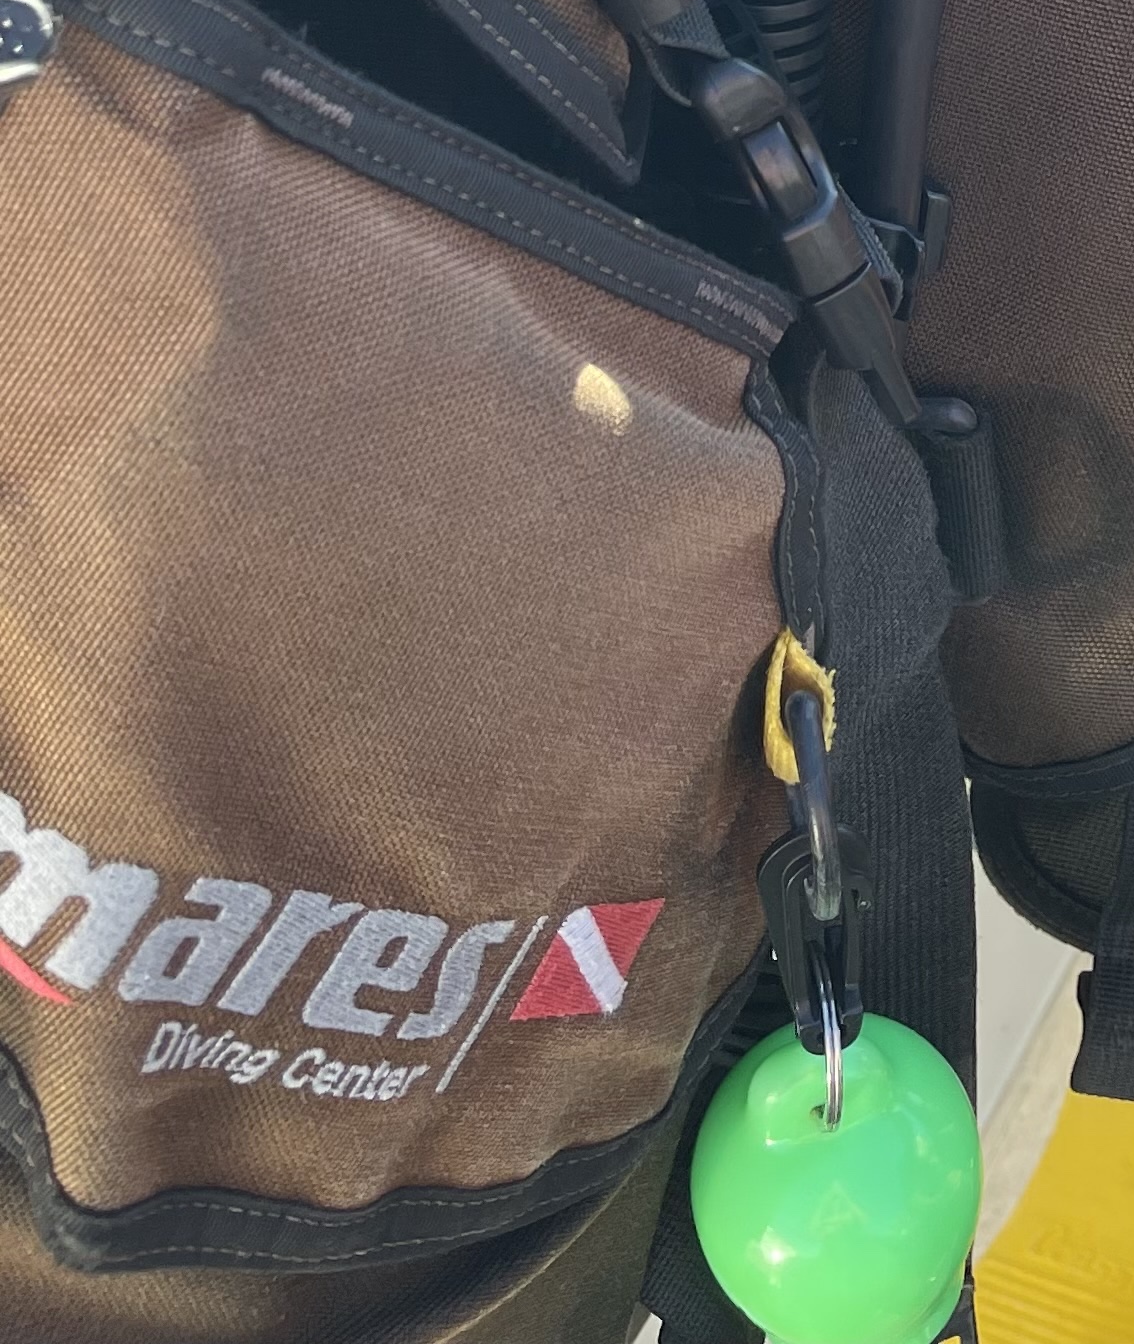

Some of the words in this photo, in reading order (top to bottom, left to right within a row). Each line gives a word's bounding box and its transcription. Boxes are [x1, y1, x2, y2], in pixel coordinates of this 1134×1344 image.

[0, 789, 516, 1040] mares
[140, 1022, 280, 1085] Diving
[282, 1047, 431, 1102] Center
